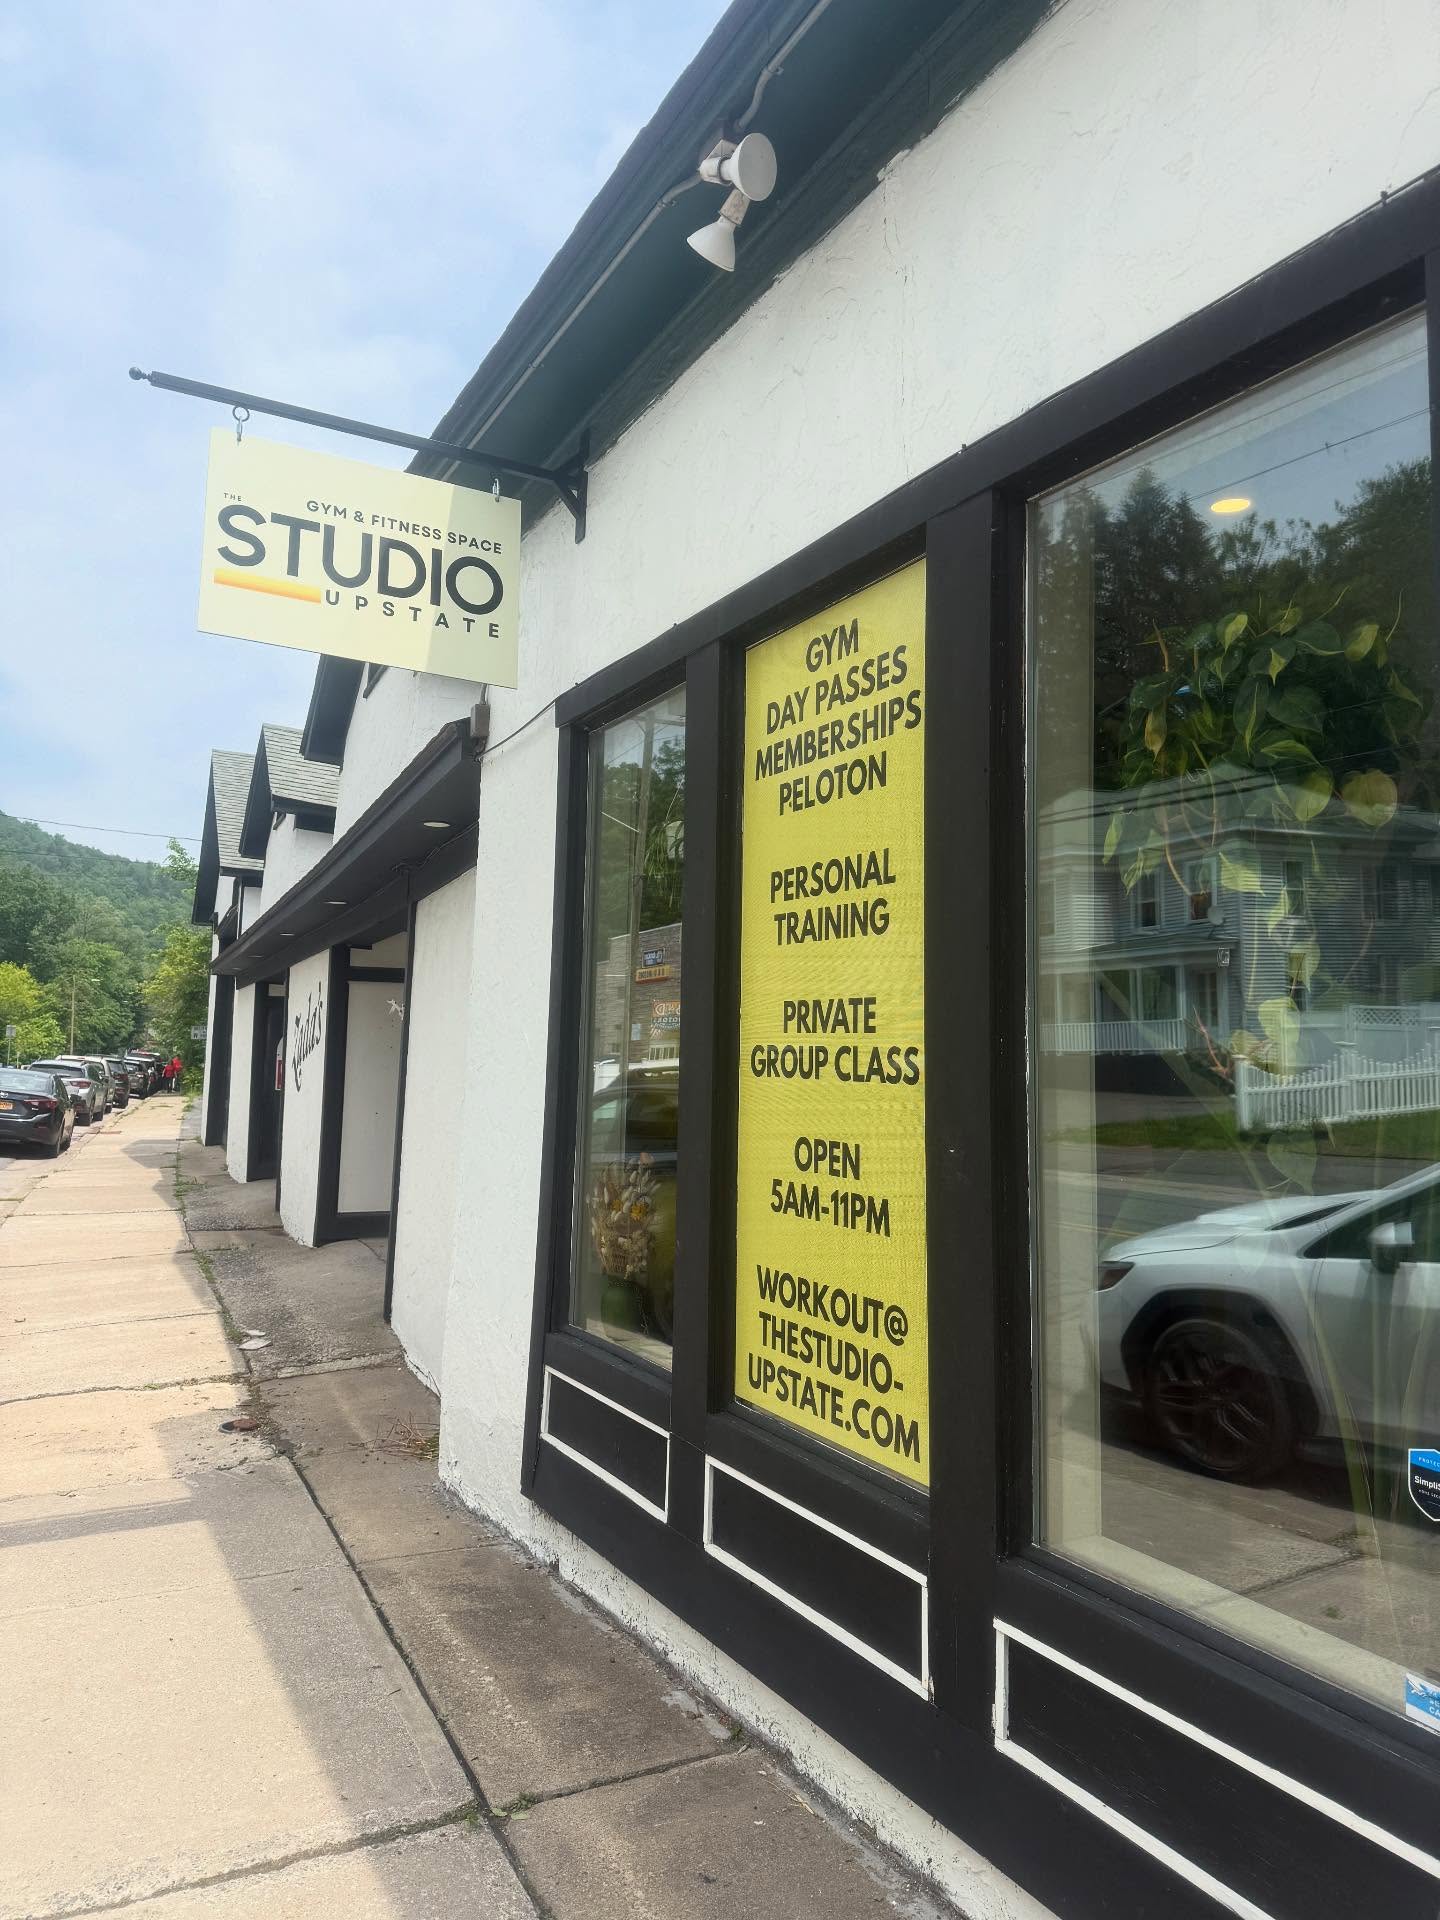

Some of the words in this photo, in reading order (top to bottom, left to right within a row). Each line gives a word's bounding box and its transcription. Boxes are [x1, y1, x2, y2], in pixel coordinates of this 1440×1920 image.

[223, 492, 242, 502] THE
[306, 500, 347, 519] GYM
[354, 510, 365, 523] &
[371, 514, 442, 541] FITNESS
[447, 531, 502, 555] SPACE
[217, 504, 504, 616] STUDIO
[325, 589, 499, 638] UPSTATE
[805, 618, 859, 673] GYM
[766, 685, 810, 735] DAY
[815, 645, 908, 716] PASSES
[755, 690, 922, 781] MEMBERSHIPS
[779, 751, 887, 816] PELOTON
[770, 848, 897, 904] PERSONAL
[774, 898, 890, 946] TRAINING
[782, 997, 877, 1034] PRIVATE
[751, 1044, 828, 1080] GROUP
[834, 1045, 920, 1086] CLASS
[794, 1136, 860, 1180] OPEN
[770, 1179, 891, 1238] 5AM-11PM
[756, 1265, 909, 1347] WORKOUT@
[758, 1311, 904, 1392] THESTUDIO-
[748, 1353, 921, 1463] UPSTATE.COM
